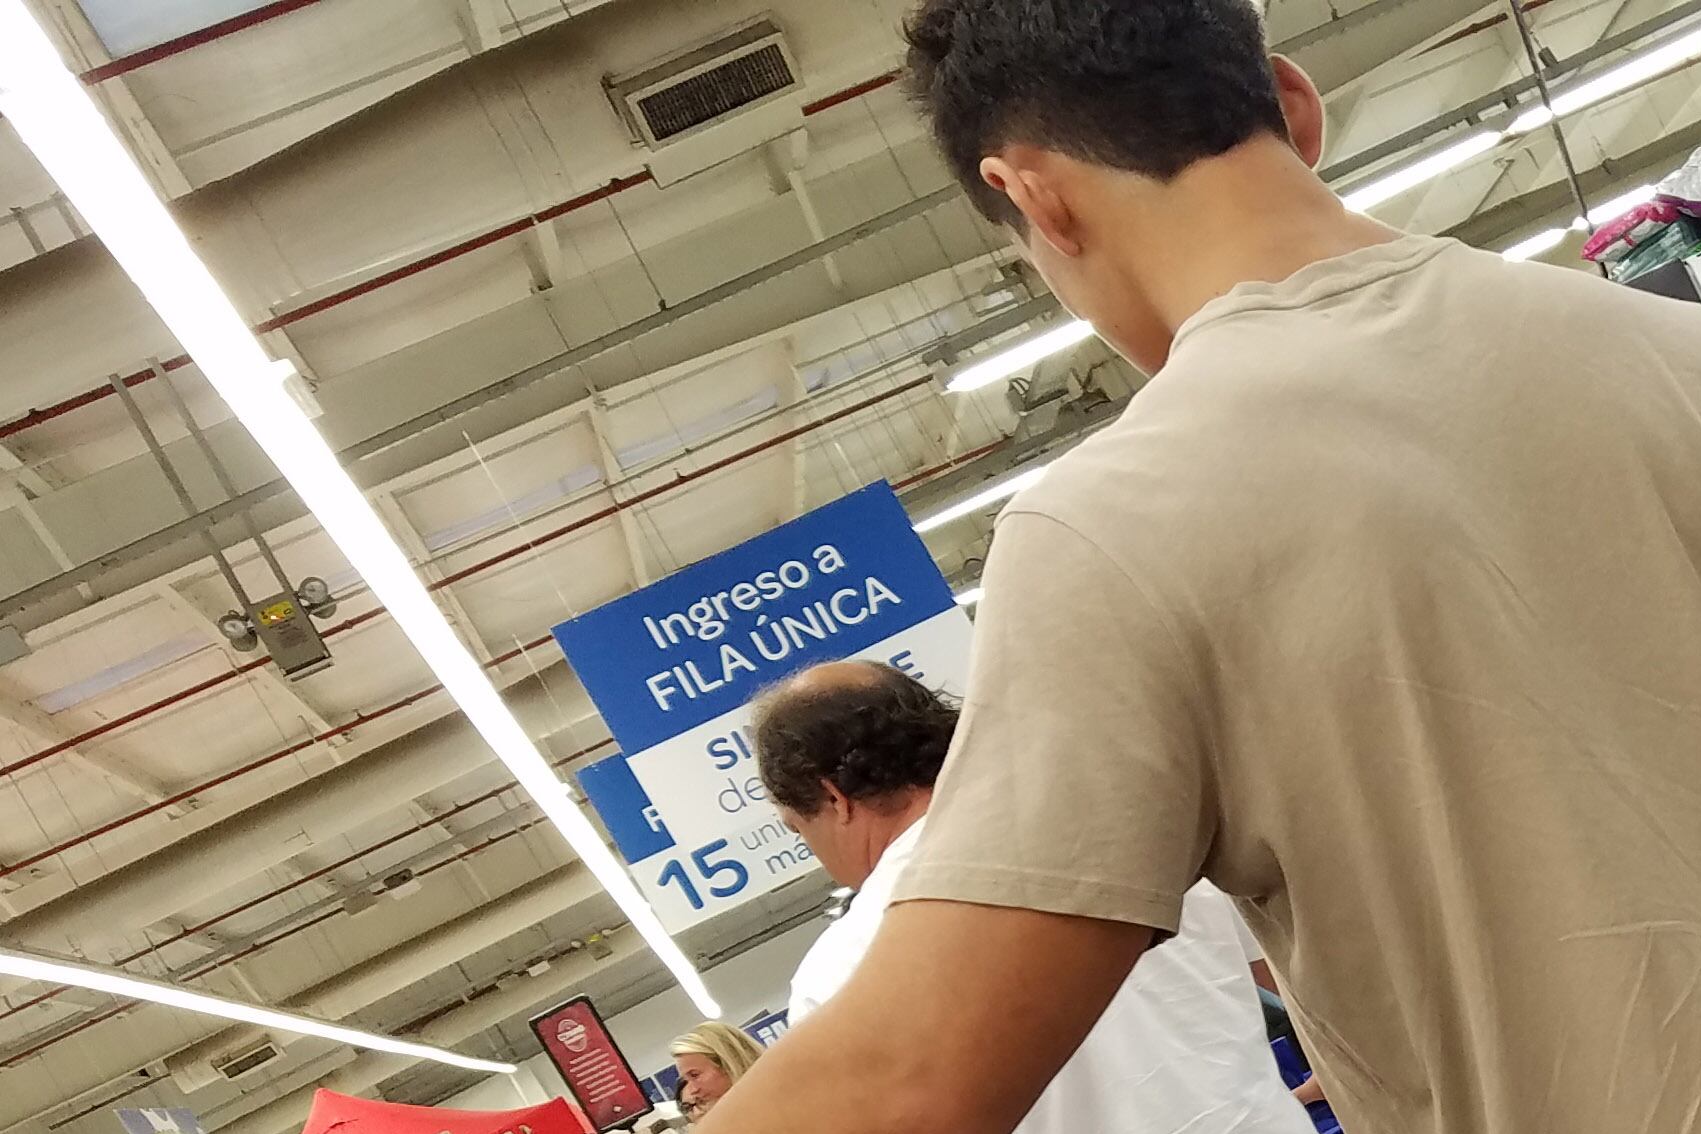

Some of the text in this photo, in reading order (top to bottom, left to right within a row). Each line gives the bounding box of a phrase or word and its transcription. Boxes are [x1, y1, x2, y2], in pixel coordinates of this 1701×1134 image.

[643, 544, 846, 650] Ingreso a
[645, 576, 902, 711] FILA ÚNICA
[657, 838, 749, 910] 15
